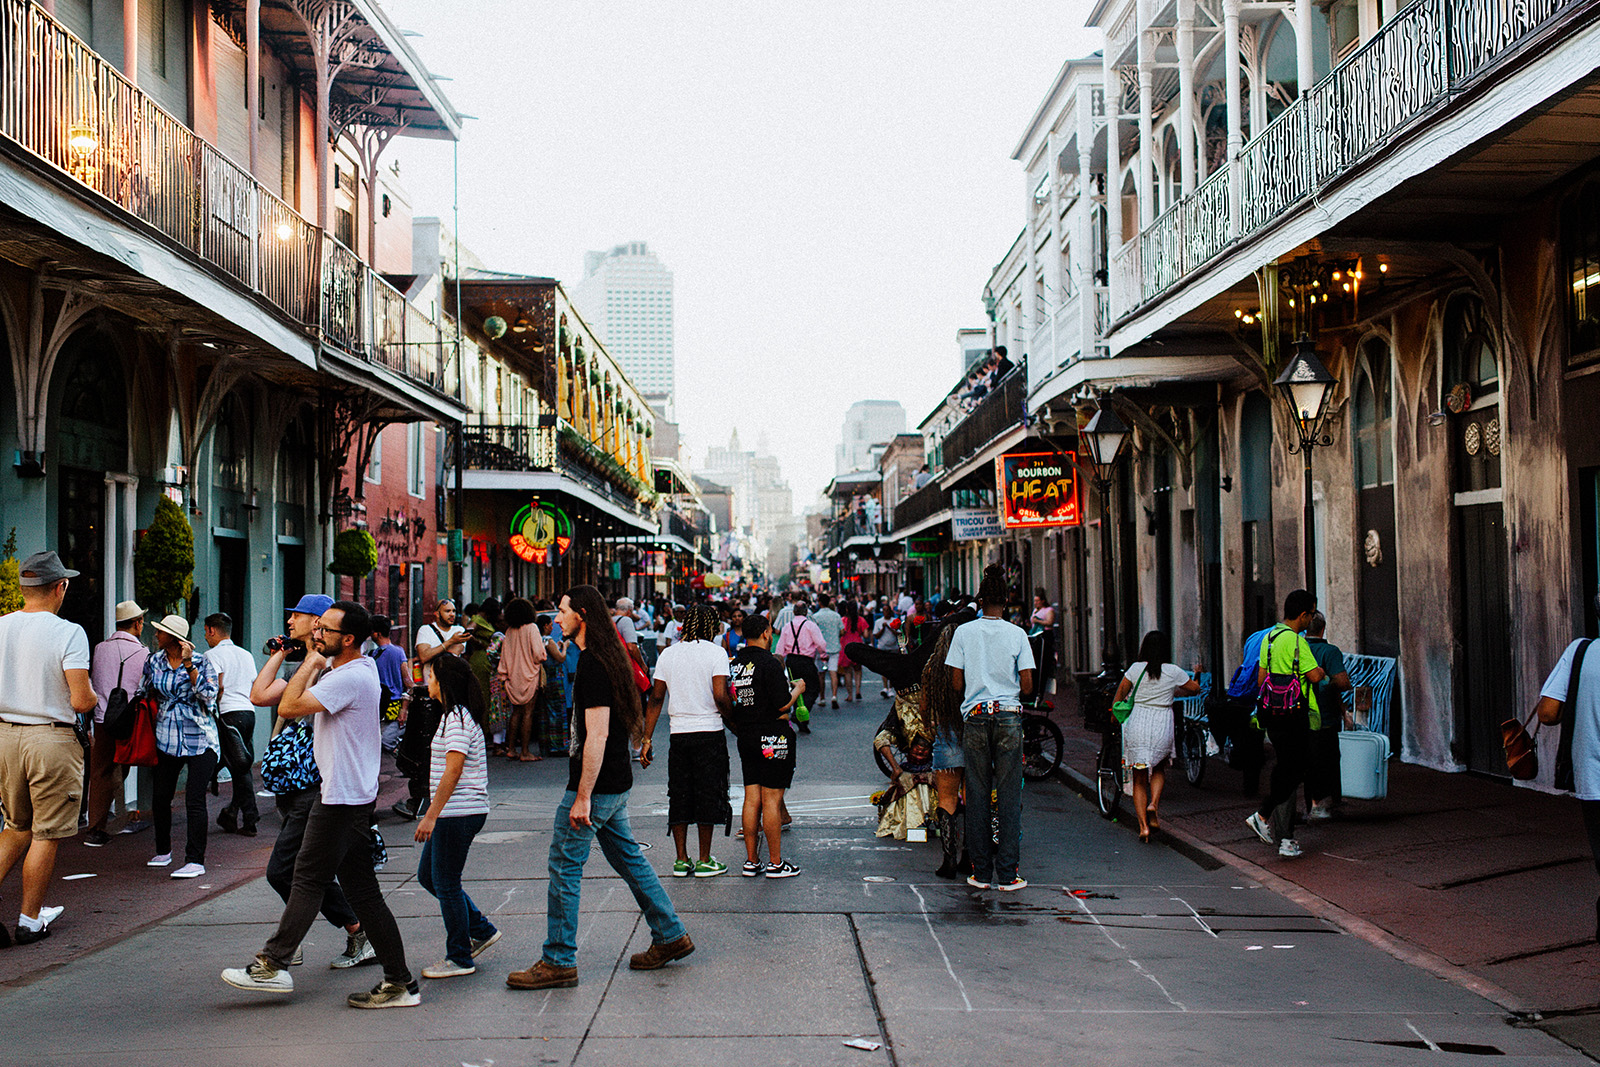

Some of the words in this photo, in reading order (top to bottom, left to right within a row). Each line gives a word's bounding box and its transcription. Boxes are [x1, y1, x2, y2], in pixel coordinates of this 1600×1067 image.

[1017, 466, 1062, 478] BOURBON
[1011, 479, 1072, 508] HEAT
[1018, 508, 1040, 518] GRILL
[1057, 503, 1075, 515] CLUB
[955, 517, 985, 526] TRICOU
[509, 534, 571, 564] CANTA
